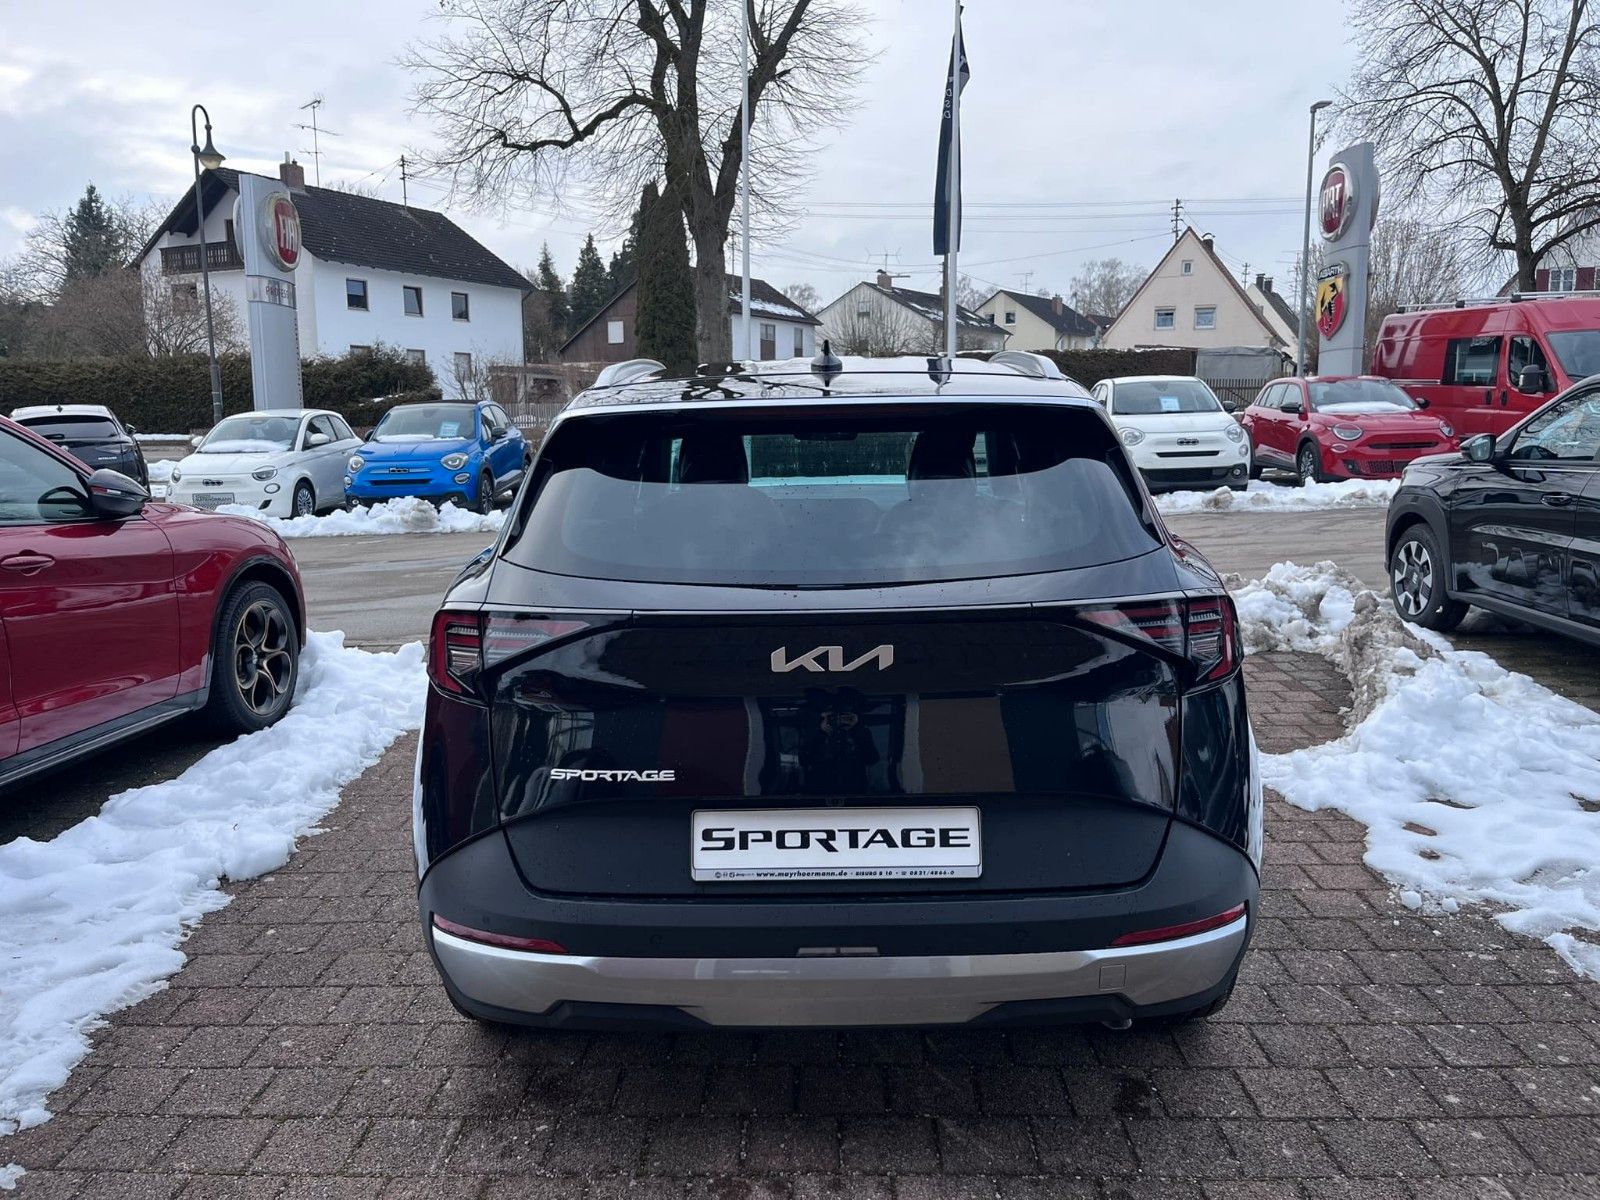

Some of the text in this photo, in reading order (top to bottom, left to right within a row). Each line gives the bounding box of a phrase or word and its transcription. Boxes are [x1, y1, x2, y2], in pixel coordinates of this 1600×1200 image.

[1322, 182, 1343, 221] FIAT
[771, 644, 894, 673] KIA
[550, 768, 676, 782] SPORTAGE
[700, 827, 971, 852] SPORTAGE
[756, 870, 848, 878] www.mayrhoermann.de
